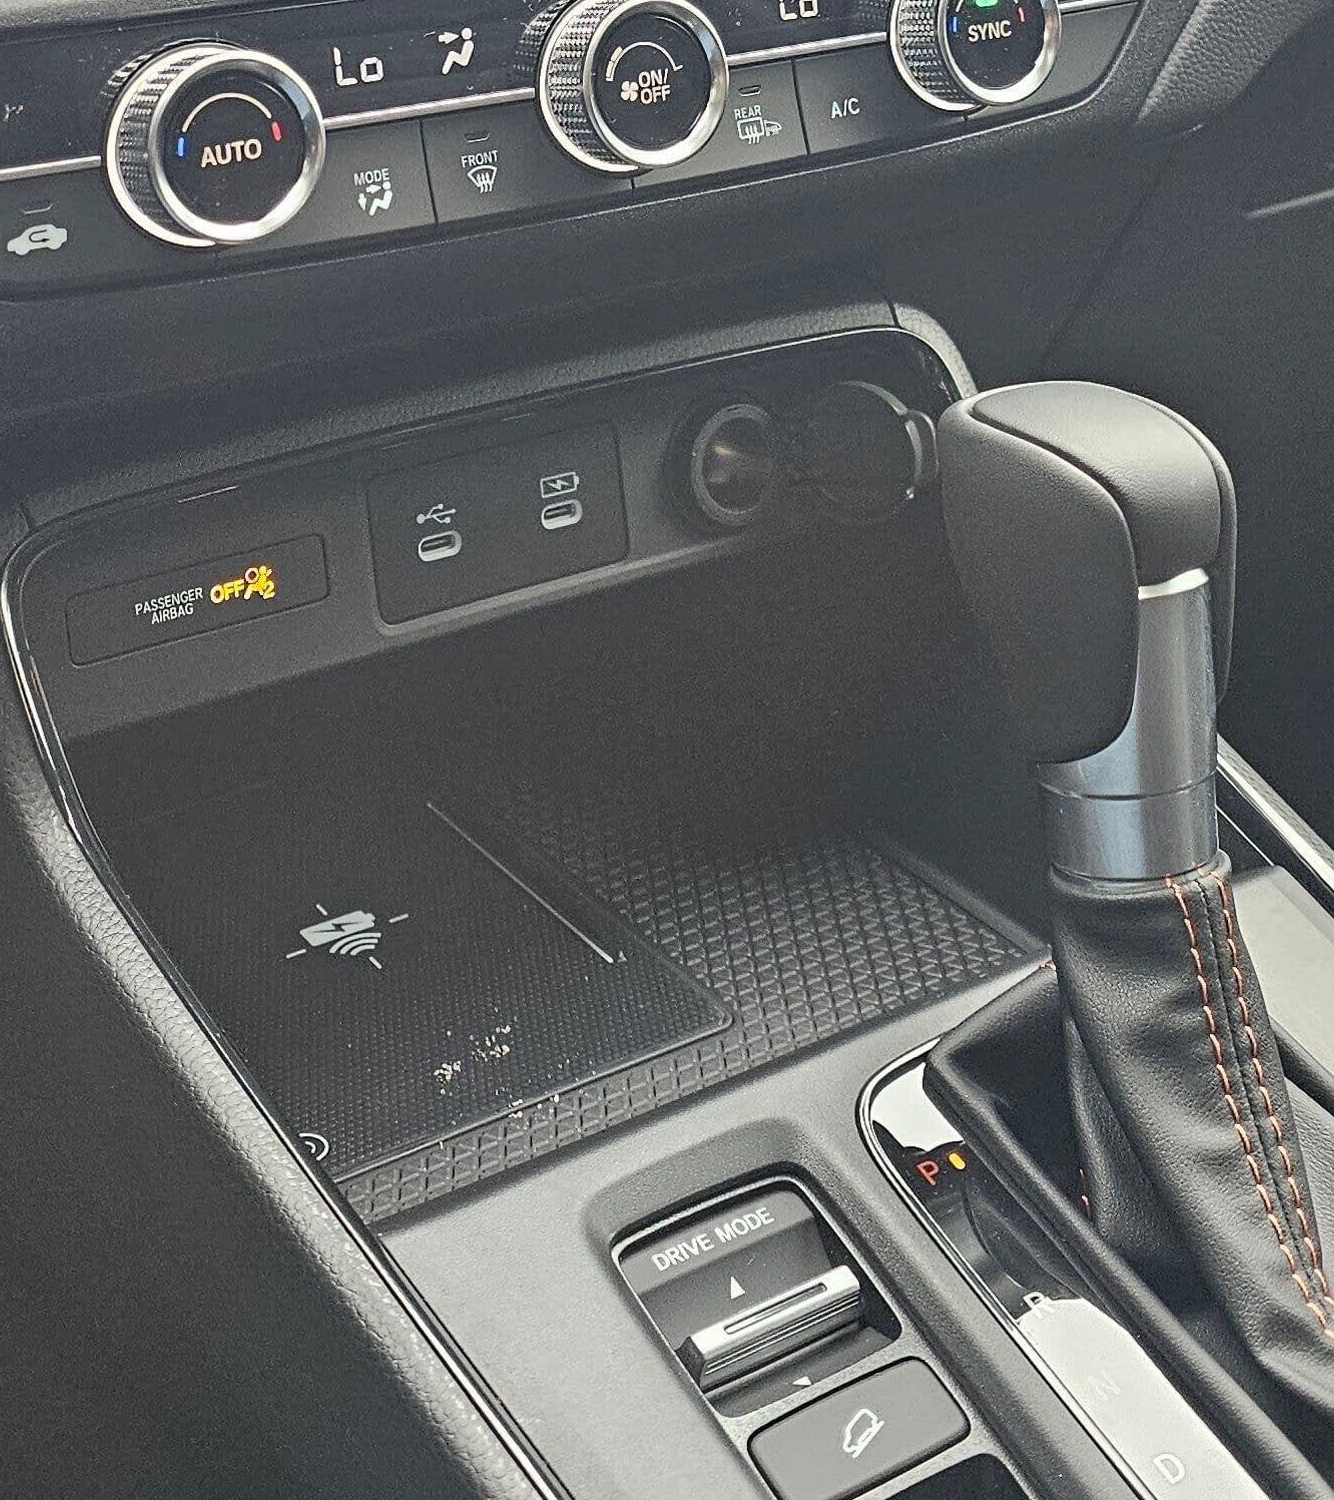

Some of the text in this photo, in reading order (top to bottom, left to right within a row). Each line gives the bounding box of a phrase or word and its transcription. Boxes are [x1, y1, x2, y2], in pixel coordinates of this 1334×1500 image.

[967, 19, 1013, 42] SYNC
[641, 85, 671, 105] OFF
[733, 105, 762, 120] REAR
[830, 98, 860, 119] A/C
[199, 138, 263, 168] AUTO
[460, 149, 499, 169] FRONT
[352, 167, 391, 188] MODE
[135, 577, 245, 615] PASSENGER OFF
[151, 602, 194, 625] AIRBAG
[917, 1161, 940, 1186] P
[651, 1206, 775, 1272] DRIVE MODE
[1153, 1453, 1185, 1485] D
